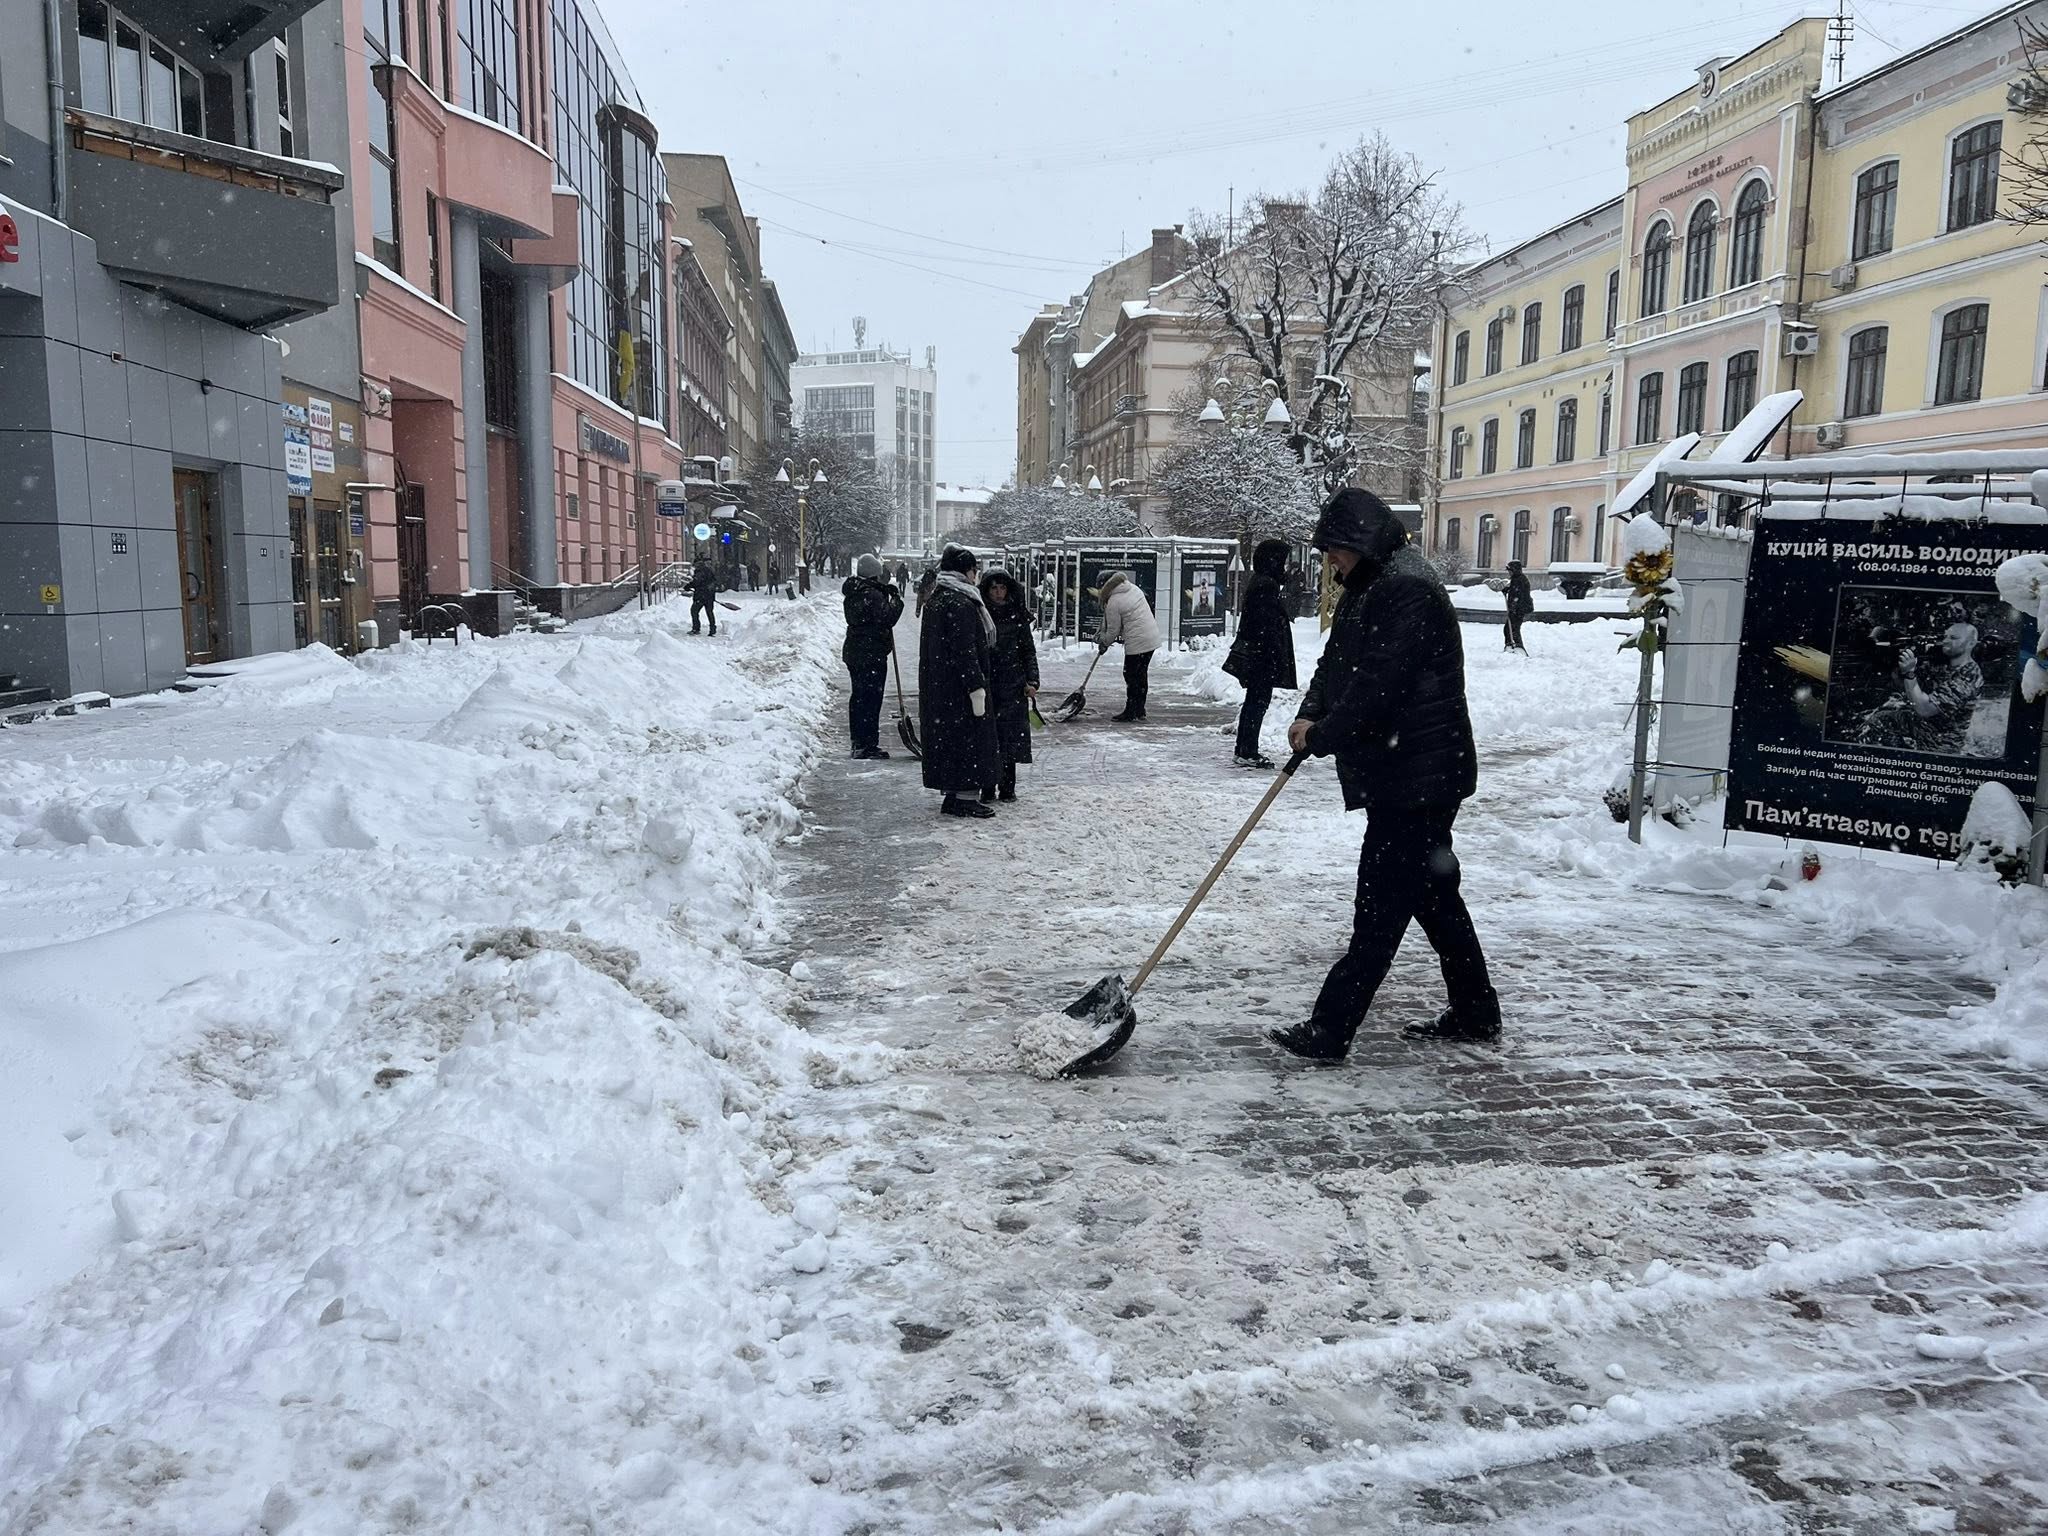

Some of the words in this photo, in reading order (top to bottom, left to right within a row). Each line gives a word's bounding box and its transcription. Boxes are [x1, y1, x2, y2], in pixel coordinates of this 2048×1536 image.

[1767, 538, 1828, 558] КУЦІЙ
[1832, 543, 1914, 559] ВАСИЛЬ
[1857, 561, 1927, 574] (08.04.1984
[1757, 743, 1801, 756] Бойовий
[1803, 749, 1837, 759] медик
[1838, 753, 1923, 769] механізованого
[1925, 763, 1963, 776] взводу
[1966, 766, 2038, 782] механізован
[1833, 761, 1917, 779] механізованого
[1765, 764, 1807, 777] Загинув
[1809, 768, 1826, 779] під
[1827, 771, 1846, 780] час
[1847, 775, 1909, 789] штурмових
[1910, 779, 1928, 791] дій
[1865, 785, 1922, 800] Донецької
[1924, 794, 1948, 804] обл.
